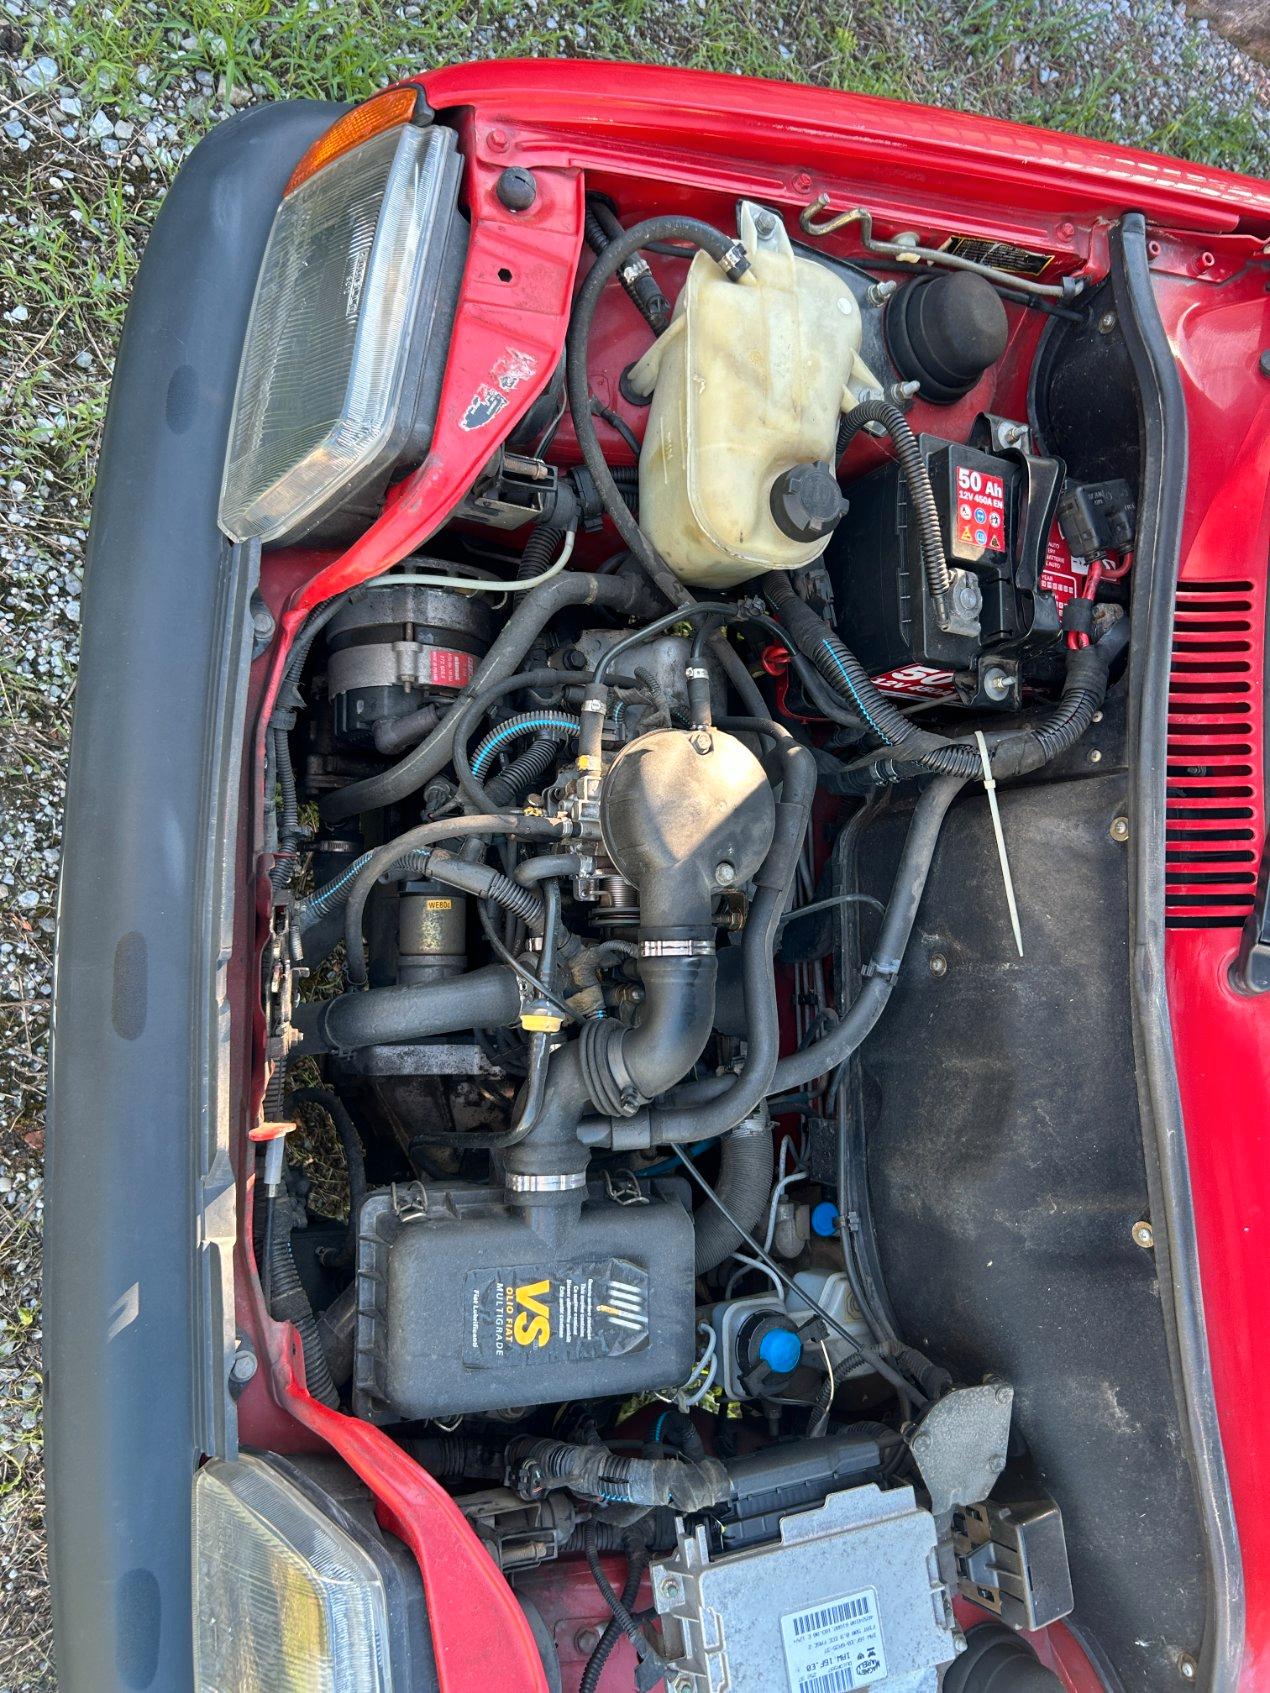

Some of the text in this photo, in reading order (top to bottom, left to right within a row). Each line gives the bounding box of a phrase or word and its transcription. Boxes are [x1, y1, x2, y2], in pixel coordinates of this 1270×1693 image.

[958, 467, 1003, 499] 50 Ah
[959, 490, 974, 501] 12V
[974, 494, 992, 506] 450A
[891, 665, 955, 685] 50
[495, 1282, 504, 1356] MULTIGRADE
[505, 1286, 514, 1343] OLIO FIAT
[514, 1279, 550, 1347] VS
